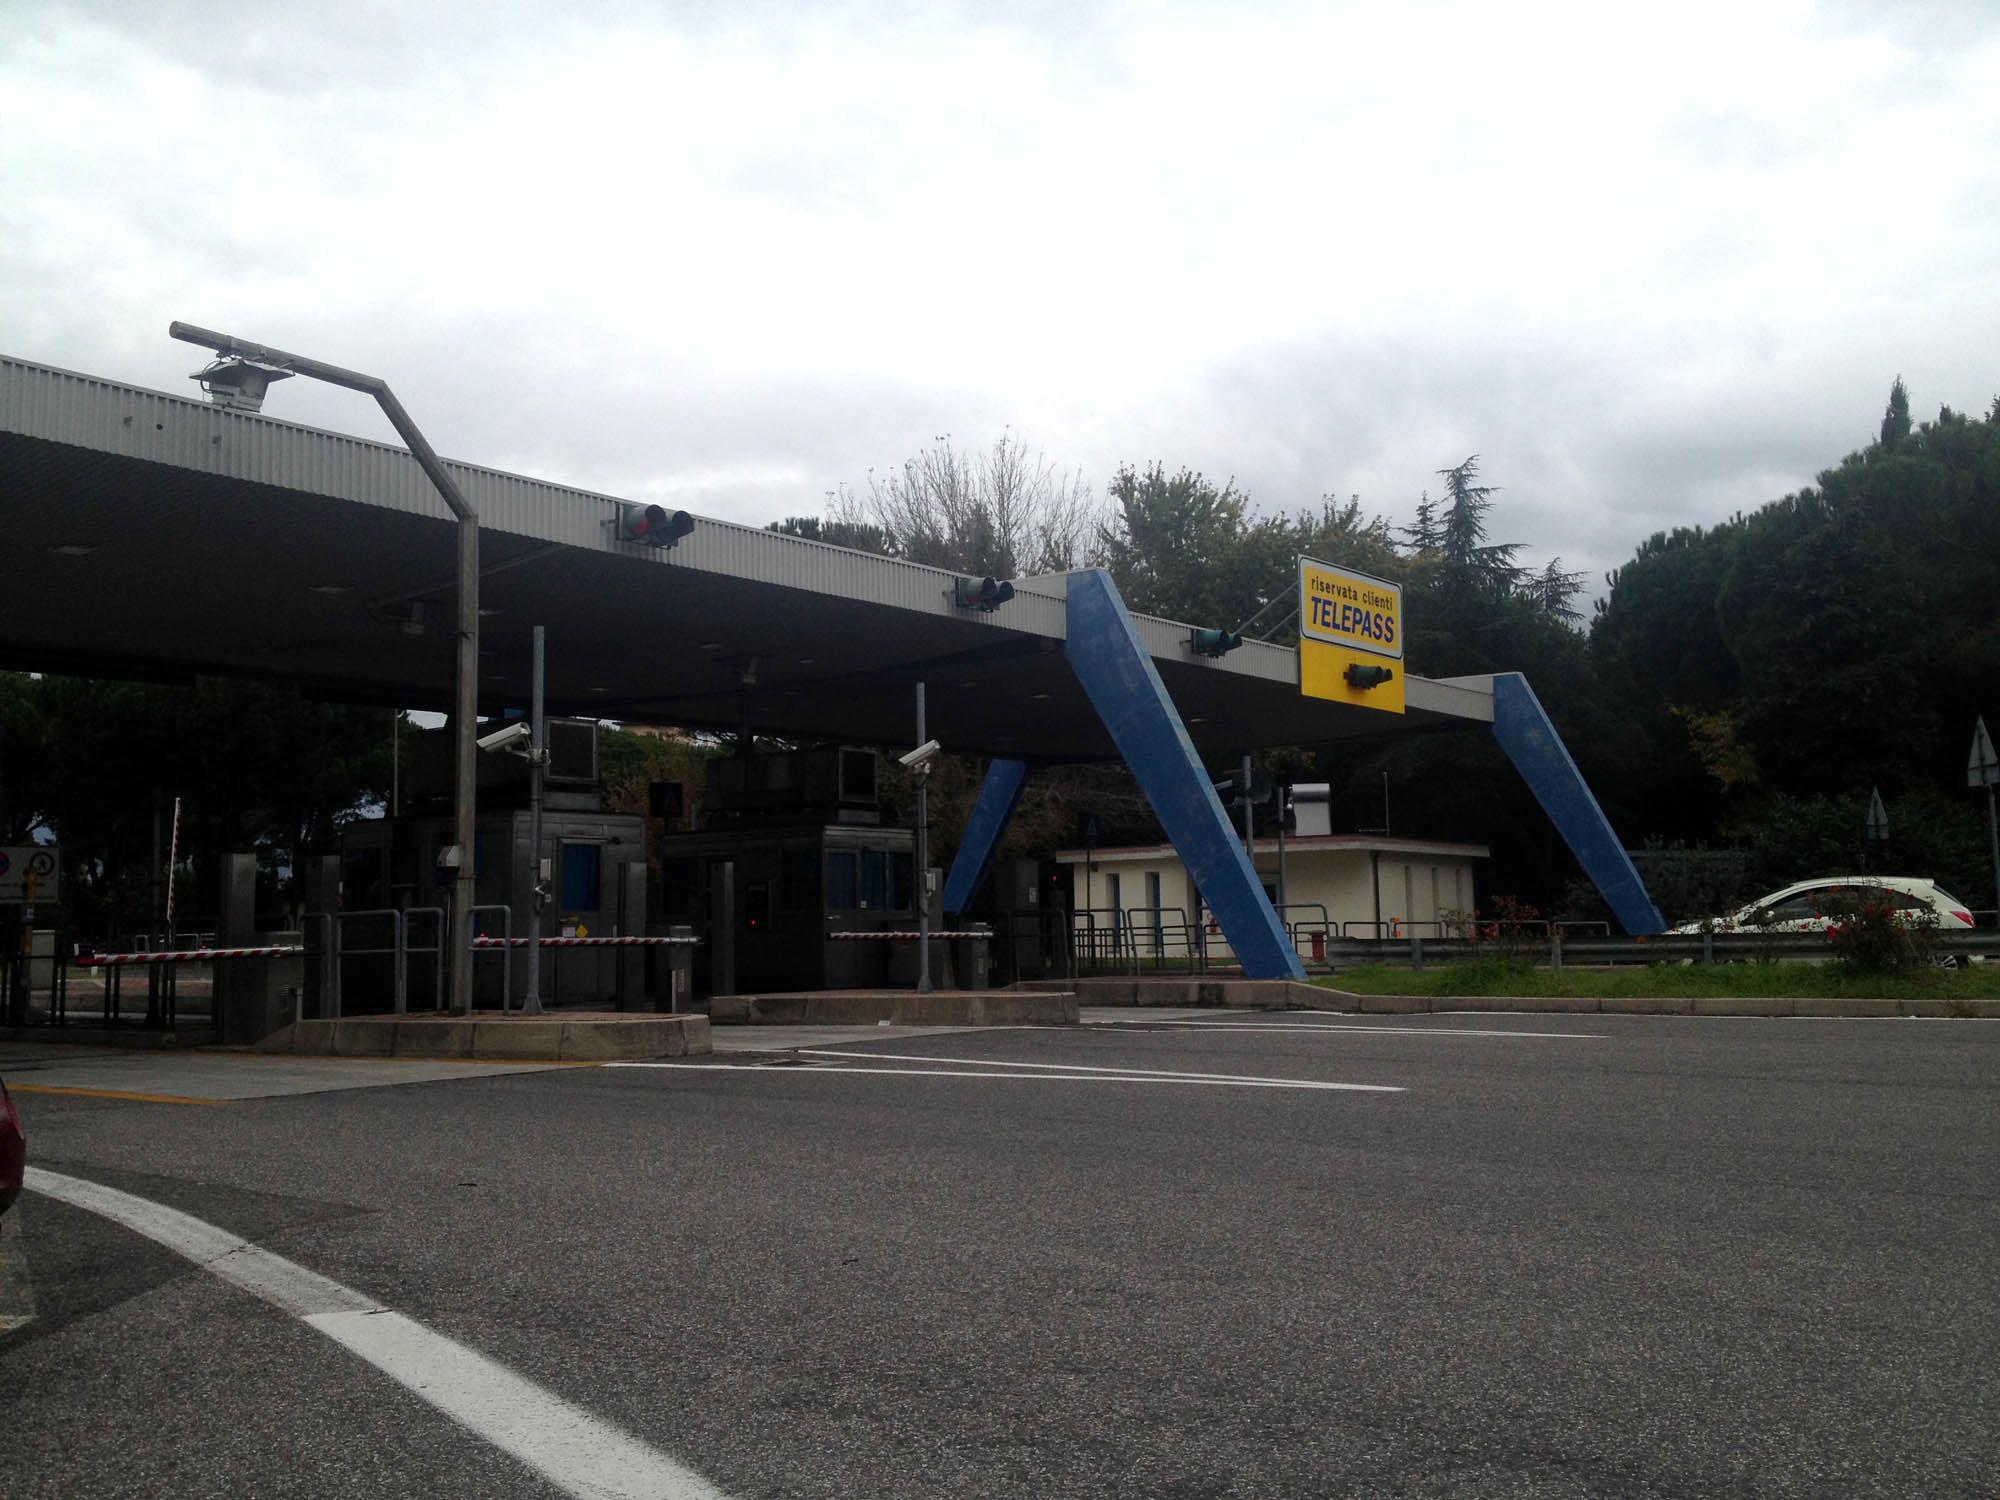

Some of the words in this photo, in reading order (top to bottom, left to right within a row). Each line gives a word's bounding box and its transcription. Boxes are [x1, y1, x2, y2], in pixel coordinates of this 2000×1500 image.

[1311, 576, 1358, 601] riservata
[1362, 591, 1393, 611] clienti
[1311, 596, 1394, 643] TELEPASS
